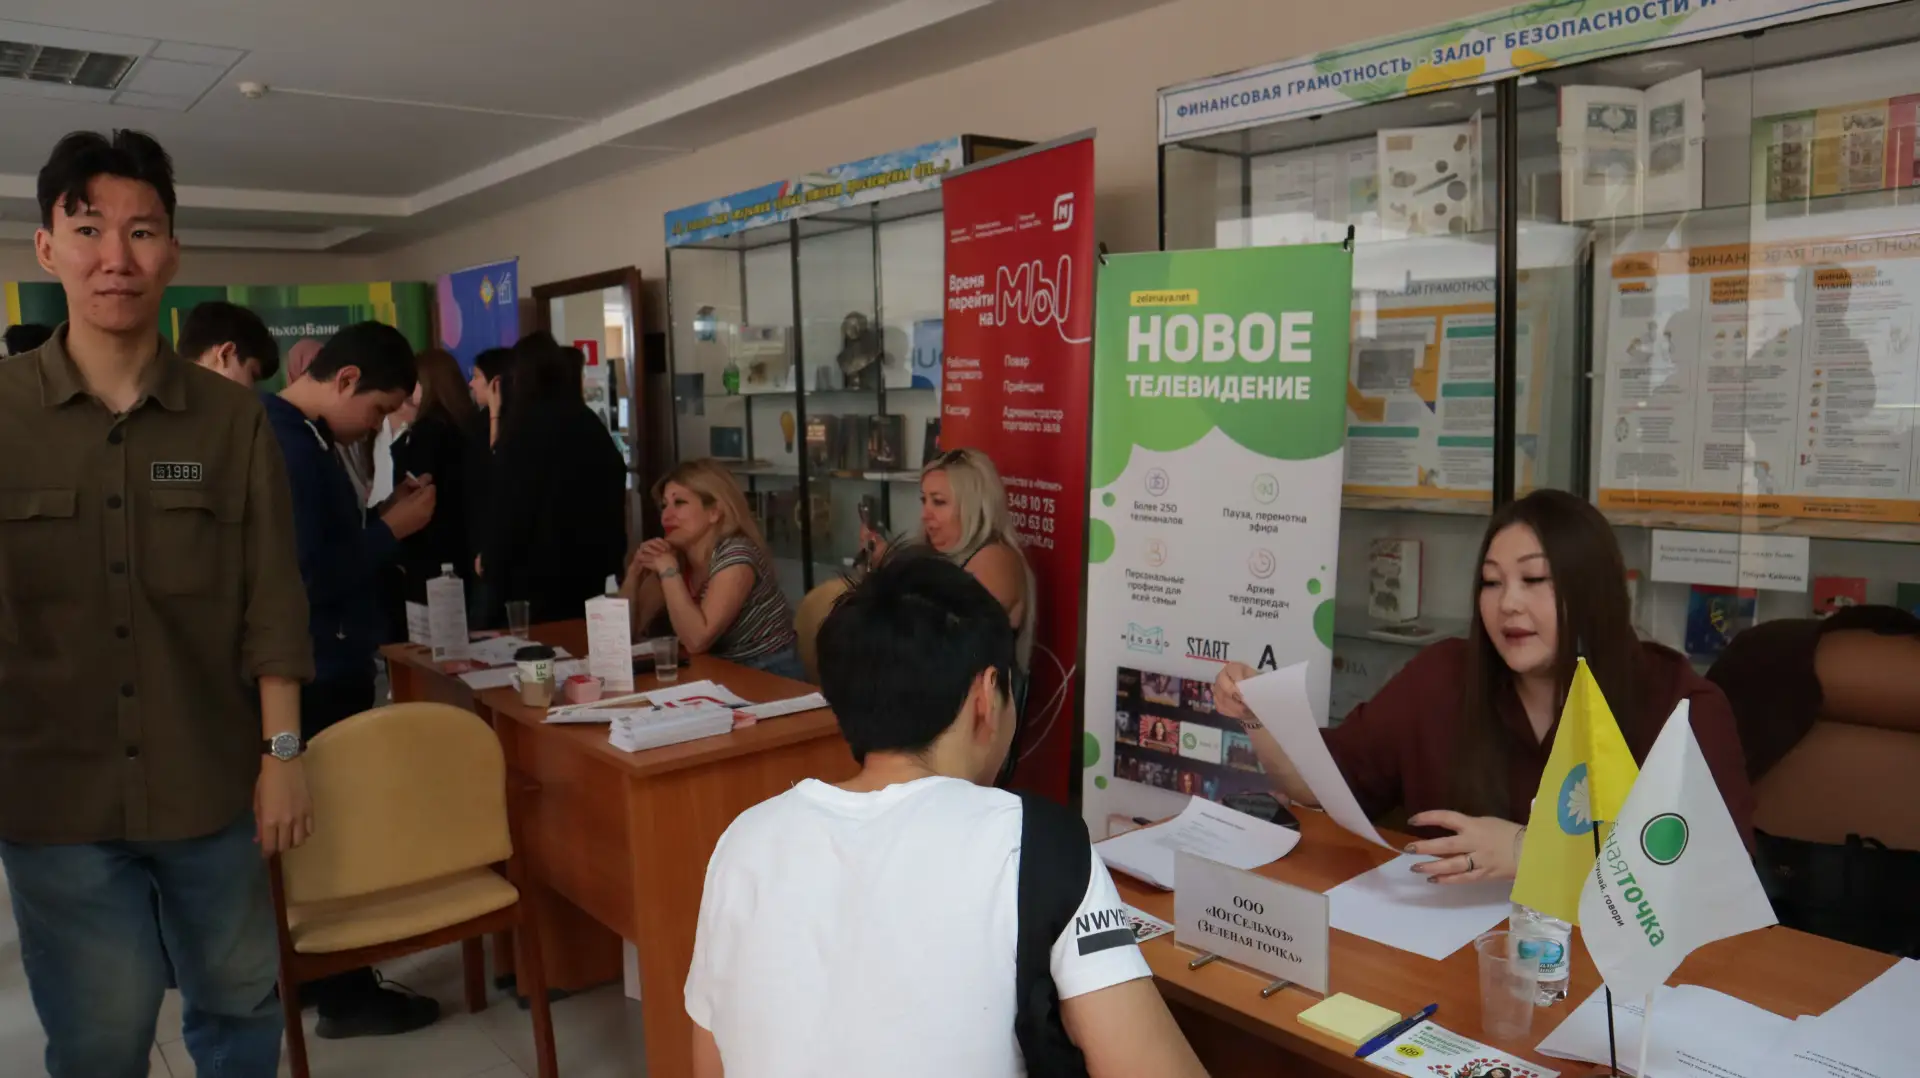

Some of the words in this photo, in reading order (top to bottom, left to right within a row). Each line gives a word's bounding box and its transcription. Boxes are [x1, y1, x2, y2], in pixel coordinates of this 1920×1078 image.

[1177, 85, 1281, 118] ФИНАНСОВАЯ
[1287, 57, 1412, 96] ГРАМОТНОСТЬ
[1433, 36, 1497, 65] ЗАЛОГ
[1504, 0, 1689, 49] БЕЗОПАСНОСТИ
[949, 274, 985, 293] Время
[948, 292, 994, 316] перейти
[979, 312, 994, 326] на
[1127, 311, 1314, 363] НОВОЕ
[1004, 355, 1030, 368] Повар
[1126, 374, 1311, 403] ТЕЛЕВИДЕНИЕ
[1003, 406, 1063, 421] Администратор
[167, 465, 198, 479] 1988
[1031, 496, 1040, 511] 10
[1043, 498, 1055, 514] 75
[1134, 501, 1157, 512] Более
[1160, 503, 1177, 513] 250
[1028, 515, 1040, 530] 63
[1042, 517, 1054, 533] 03
[1130, 513, 1183, 525] телеканалов
[1222, 507, 1253, 522] Пауза,
[1256, 513, 1307, 526] перемотка
[1249, 523, 1279, 534] эфира
[1125, 568, 1184, 585] Персональные
[1127, 582, 1164, 595] профили
[1165, 586, 1182, 596] для
[1246, 583, 1275, 596] Архив
[1131, 592, 1150, 603] всей
[1152, 595, 1176, 606] семьи
[1228, 593, 1289, 609] телепередач
[1241, 606, 1253, 616] 14
[1255, 609, 1279, 619] дней
[1186, 637, 1230, 661] START
[1233, 895, 1264, 915] ООО
[1604, 894, 1625, 928] говори
[1399, 1046, 1420, 1057] 400
